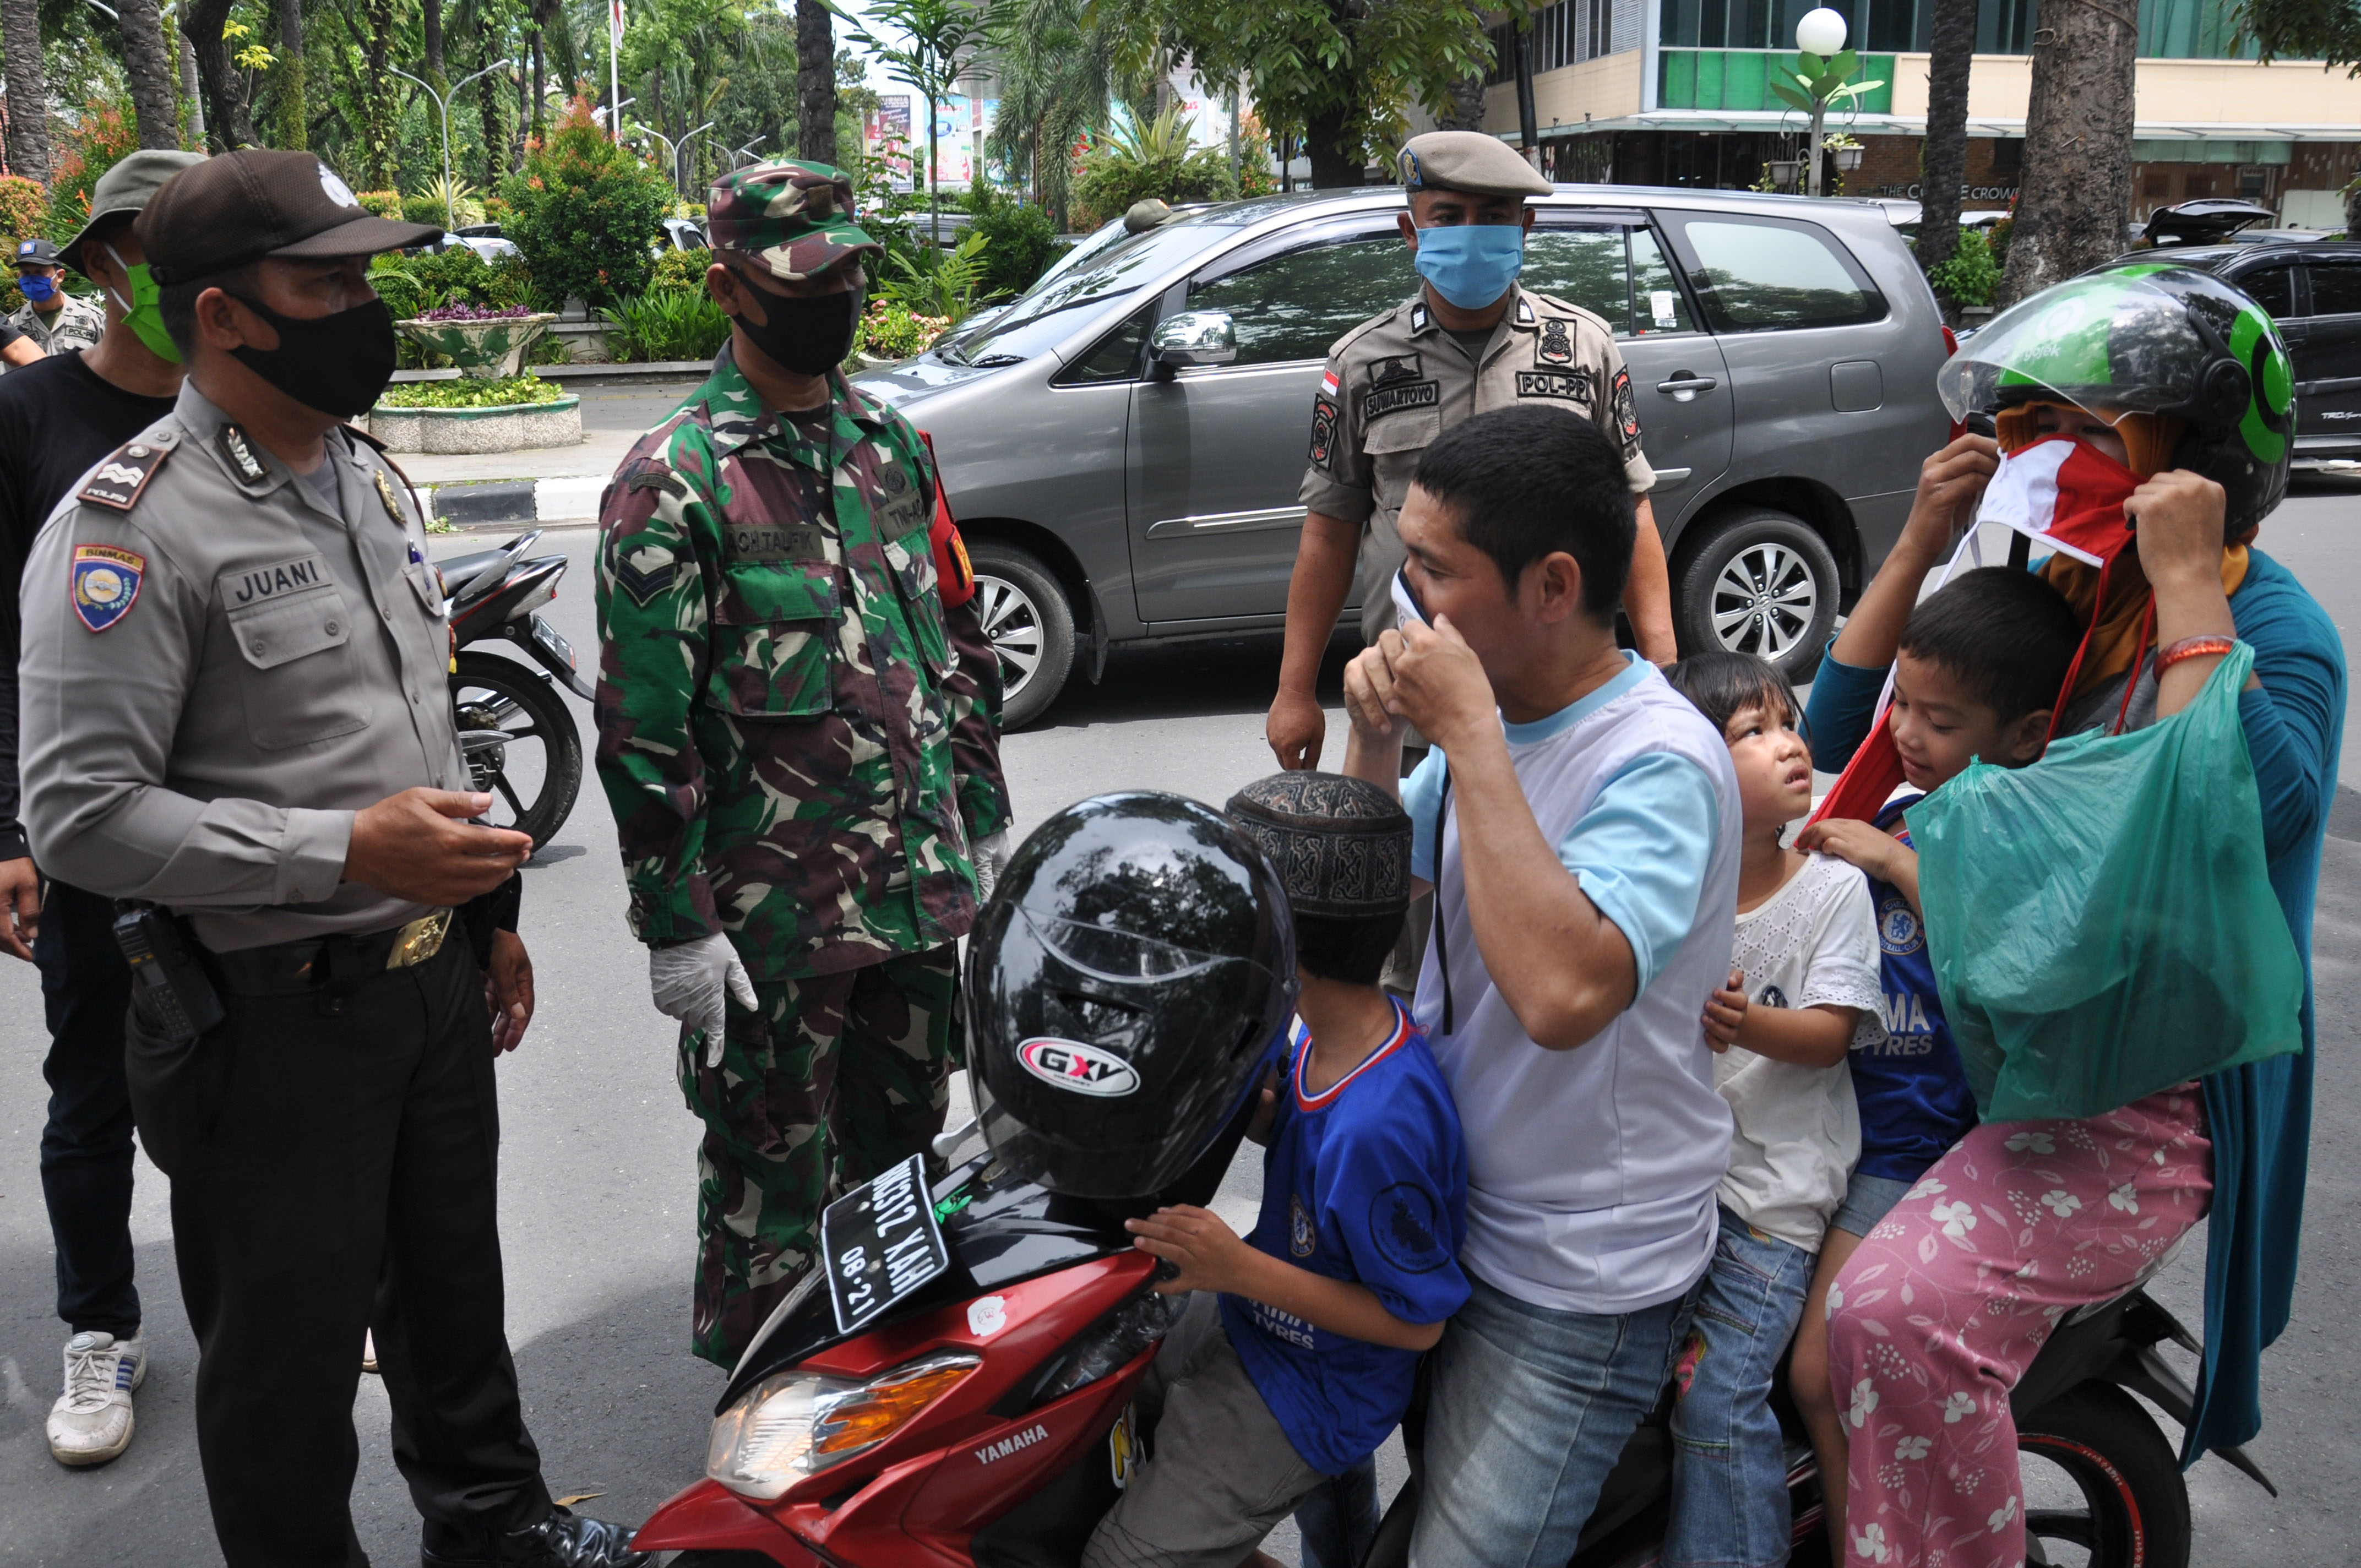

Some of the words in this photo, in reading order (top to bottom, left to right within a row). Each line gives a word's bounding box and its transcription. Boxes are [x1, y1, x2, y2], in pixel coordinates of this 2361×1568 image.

[1880, 185, 1904, 197] THE
[1971, 187, 2020, 200] CROW
[68, 328, 95, 339] POL-PP
[2023, 344, 2061, 362] gojek
[1522, 374, 1587, 398] POL-PP
[1368, 385, 1433, 415] SUWARTOYO
[86, 488, 128, 503] POLISI
[86, 548, 135, 565] BINMAS
[236, 560, 319, 602] JUANI
[883, 1227, 935, 1294] XAH
[1253, 1310, 1314, 1350] TYRES
[975, 1424, 1049, 1465] YAMAHA
